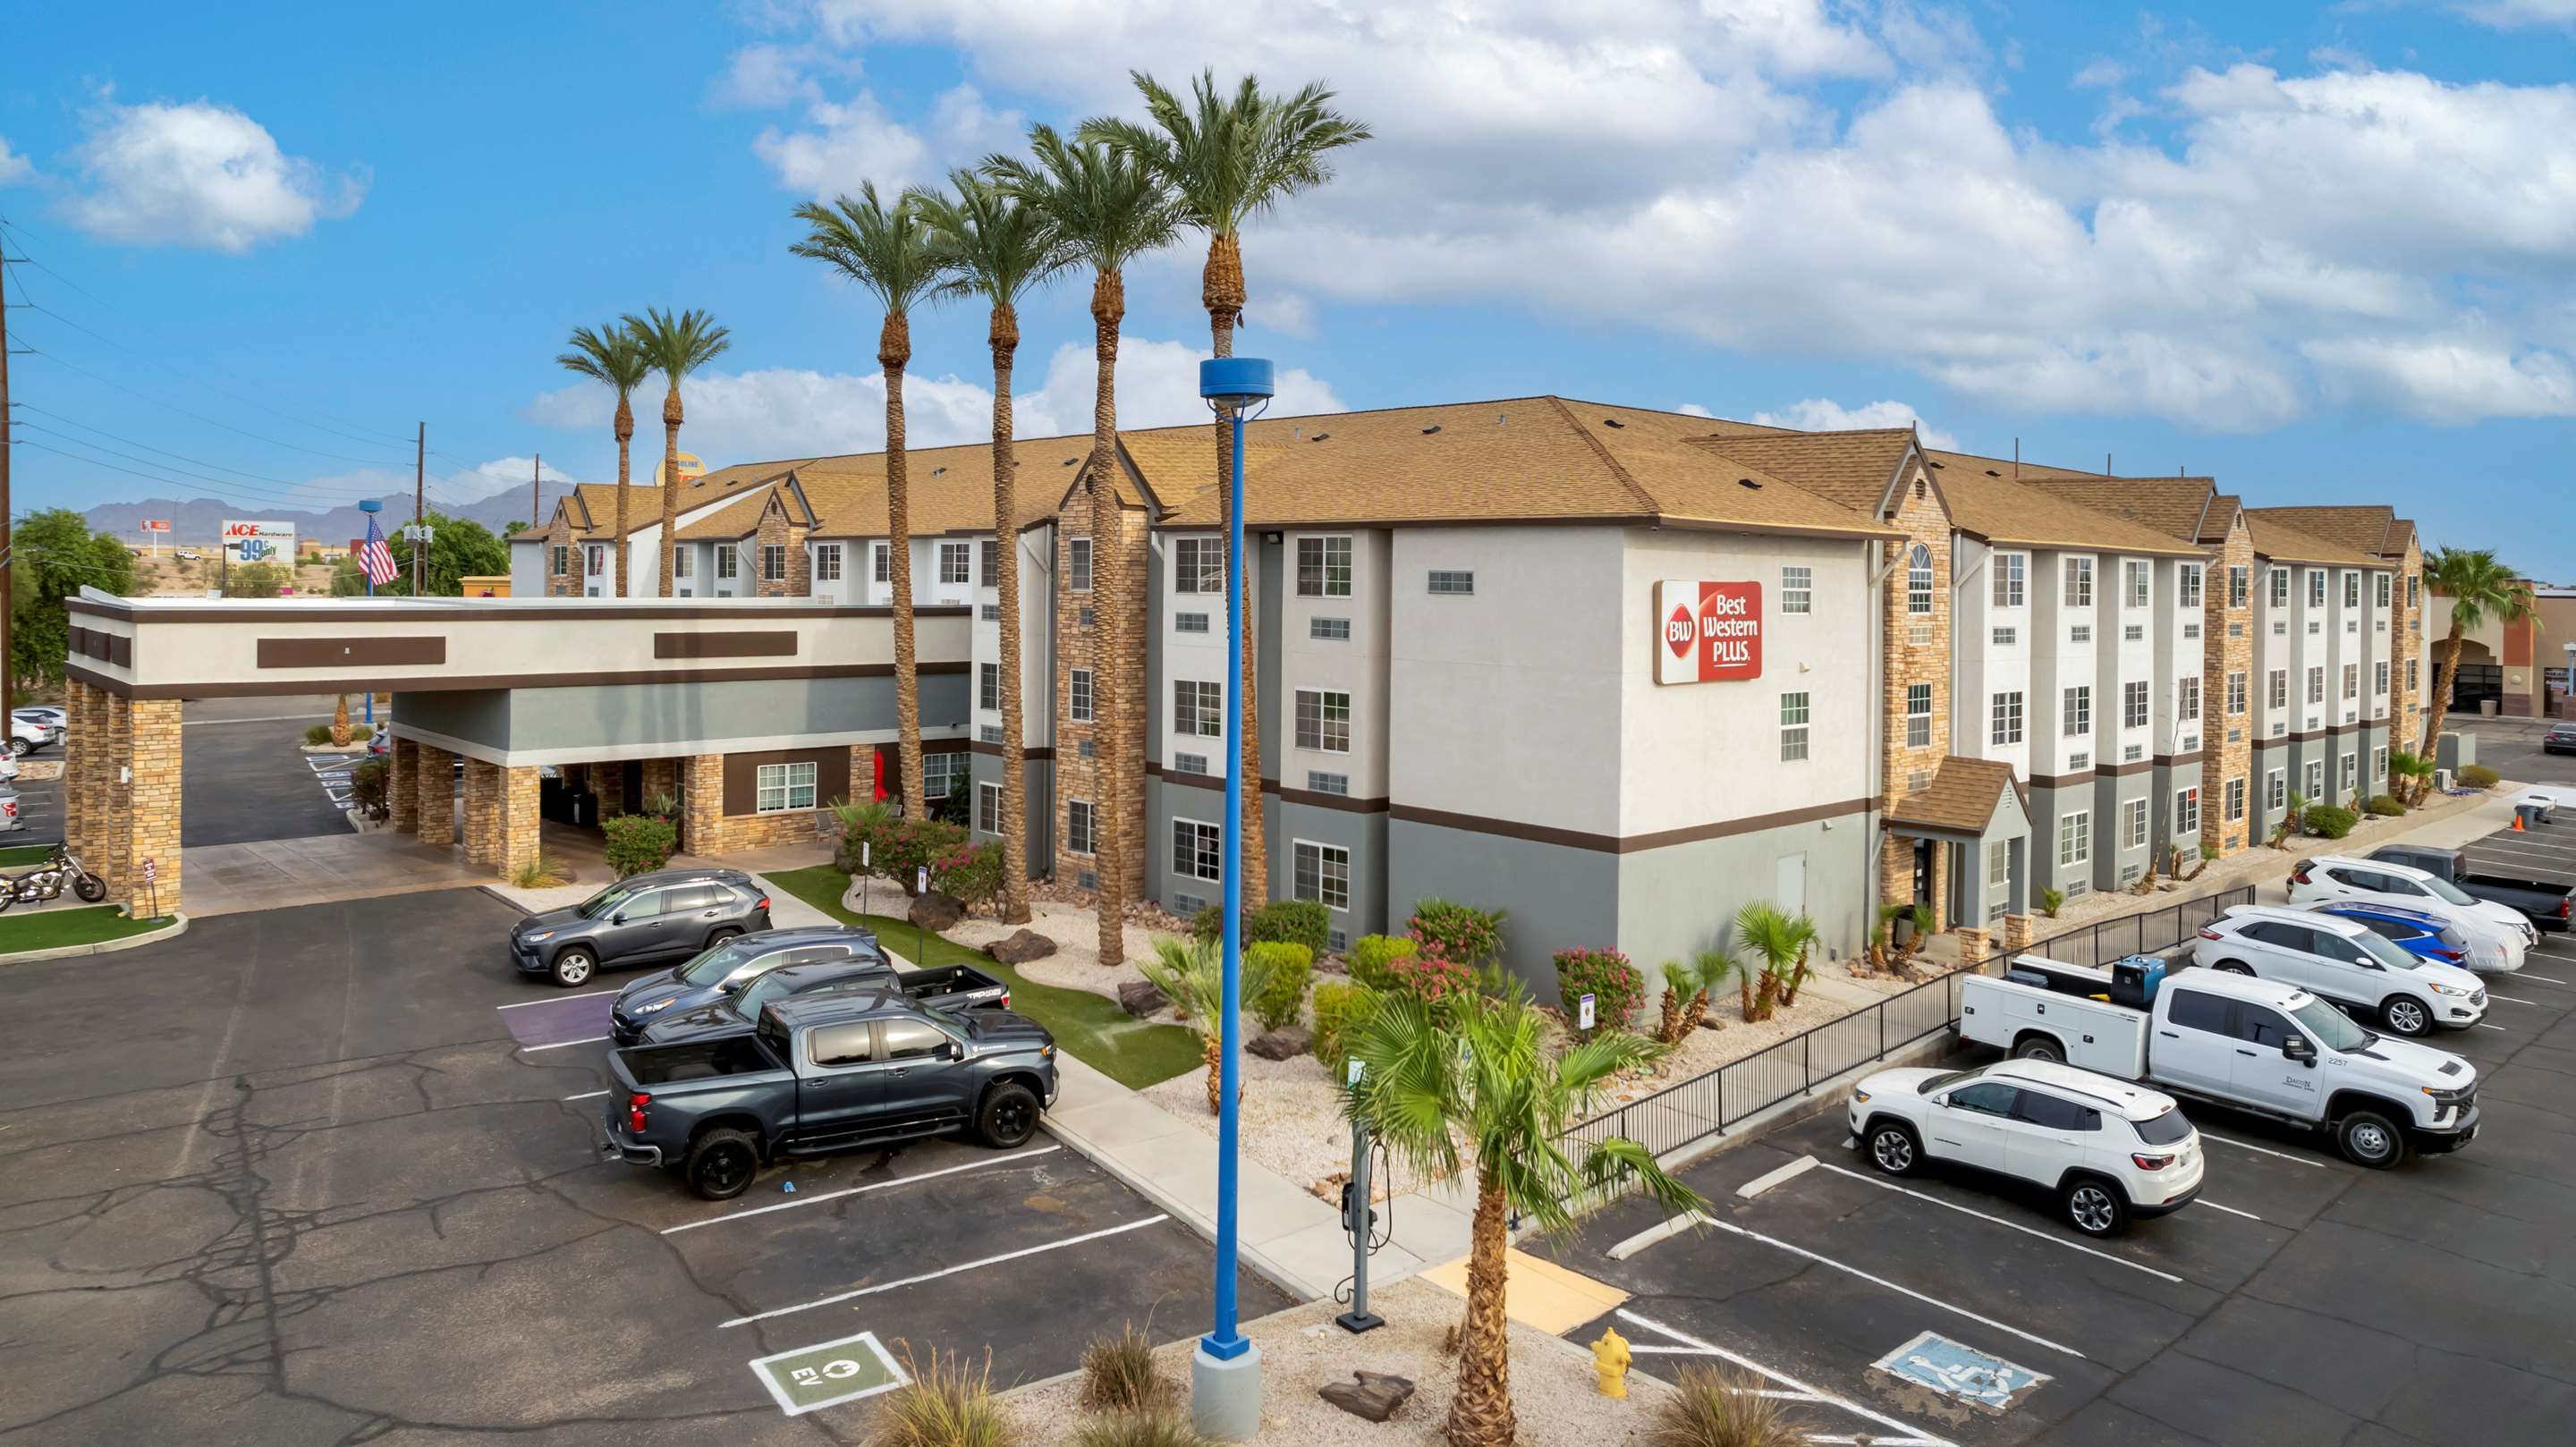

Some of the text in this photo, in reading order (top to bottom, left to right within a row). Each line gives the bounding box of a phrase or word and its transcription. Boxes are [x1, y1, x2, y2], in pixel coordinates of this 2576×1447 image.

[225, 523, 259, 536] ACE
[1717, 594, 1746, 615] Best
[1669, 622, 1692, 642] BW
[1702, 616, 1758, 638] Western
[1713, 640, 1749, 662] PLUS
[791, 1367, 823, 1386] EV
